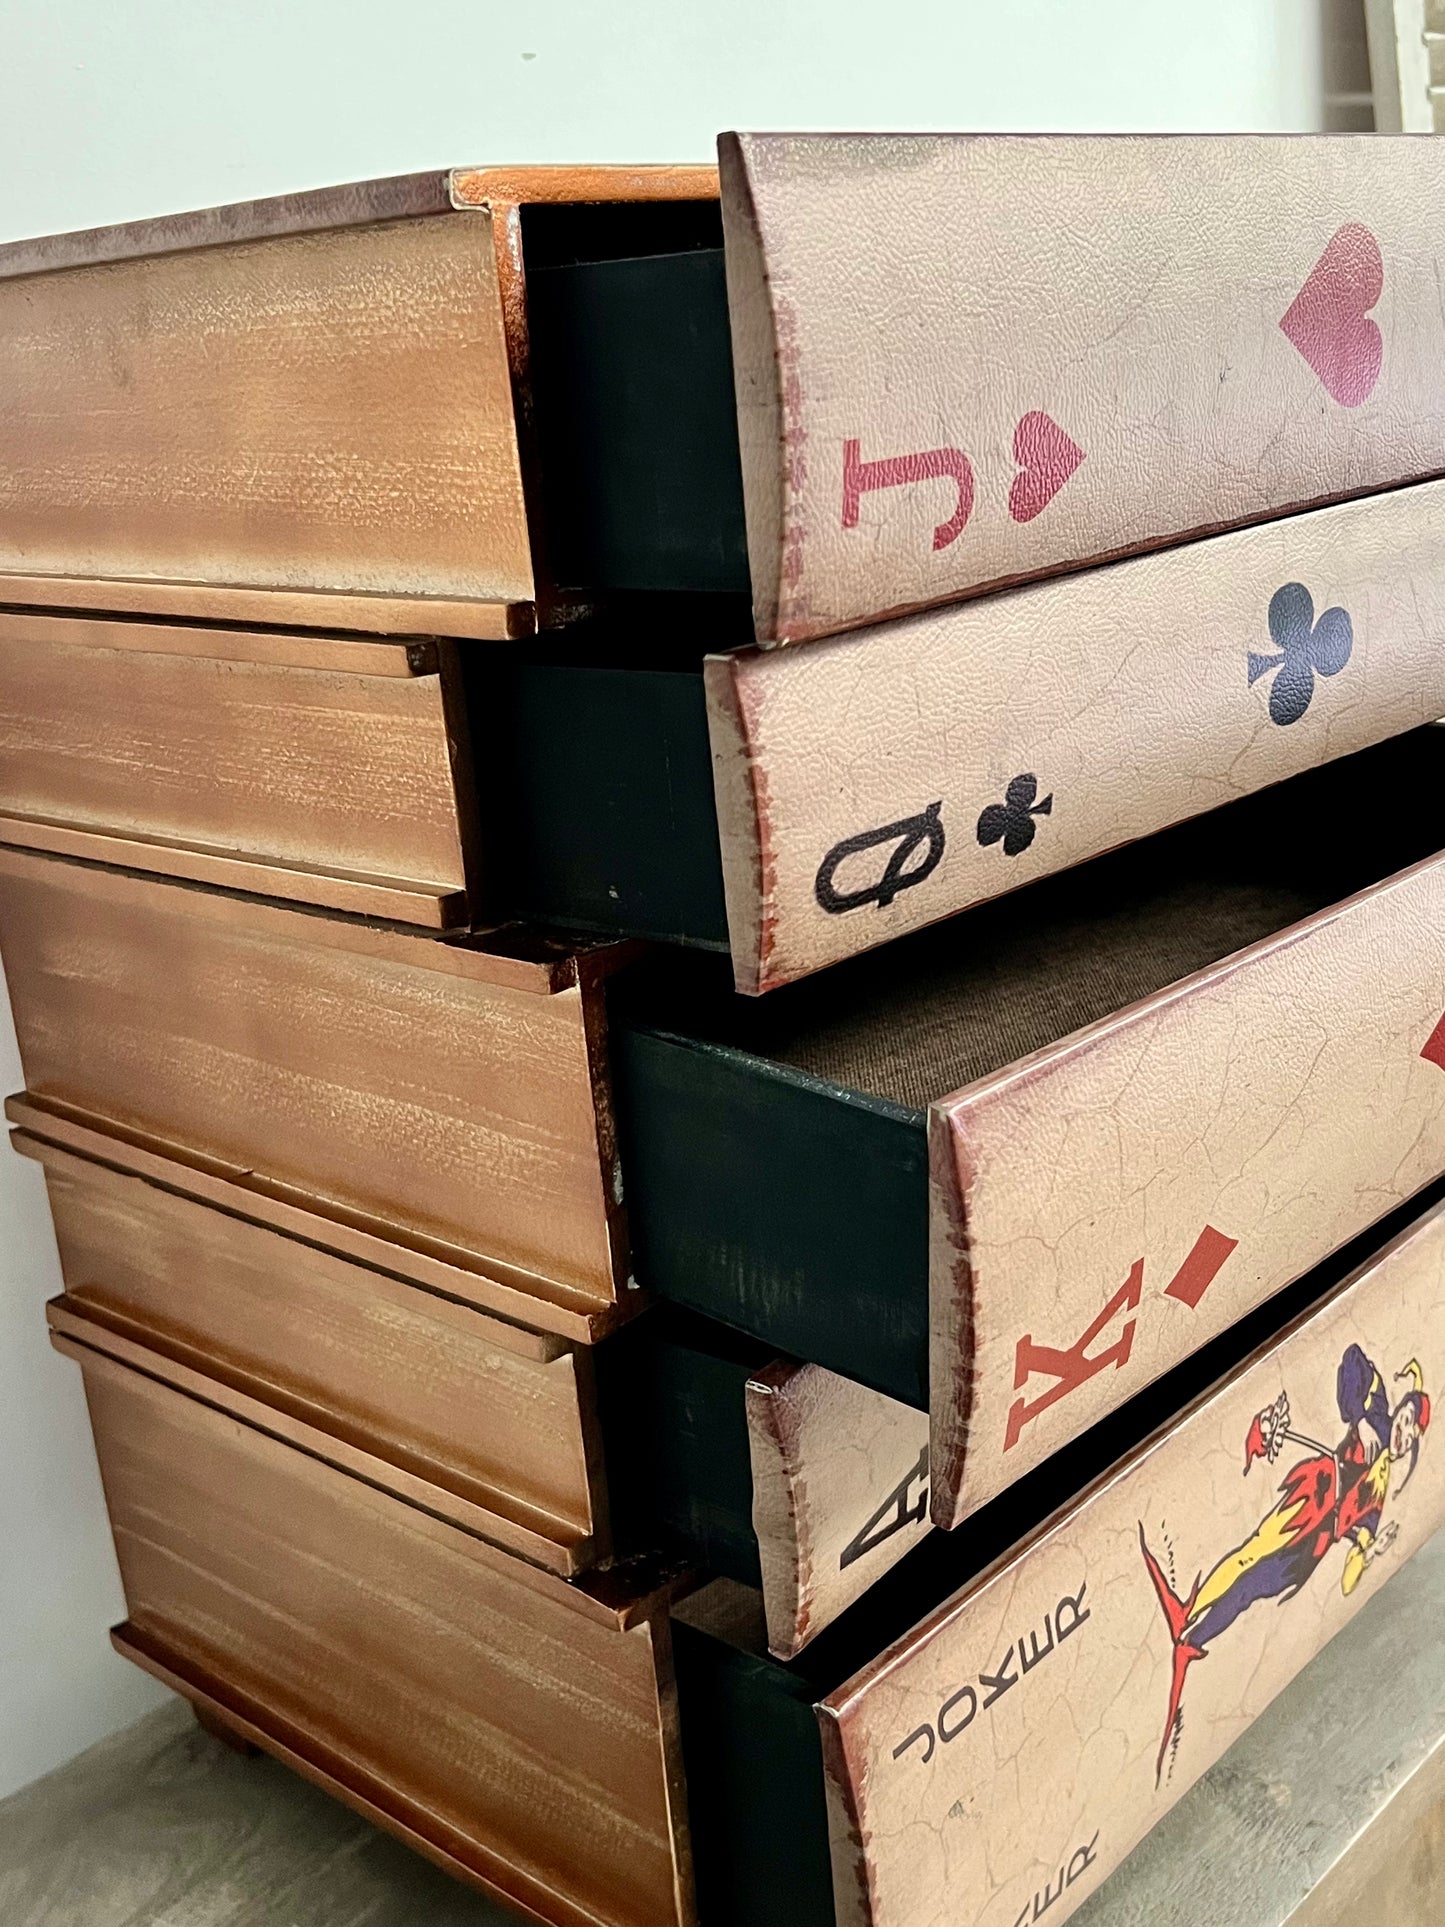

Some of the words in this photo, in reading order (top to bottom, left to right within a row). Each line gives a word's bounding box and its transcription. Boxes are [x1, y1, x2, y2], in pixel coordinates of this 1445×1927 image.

[842, 438, 974, 551] J
[815, 800, 945, 914] Q
[1003, 1257, 1144, 1452] K
[840, 1443, 929, 1571] A
[892, 1581, 1090, 1763] JOKER
[1013, 1829, 1099, 1927] ER
